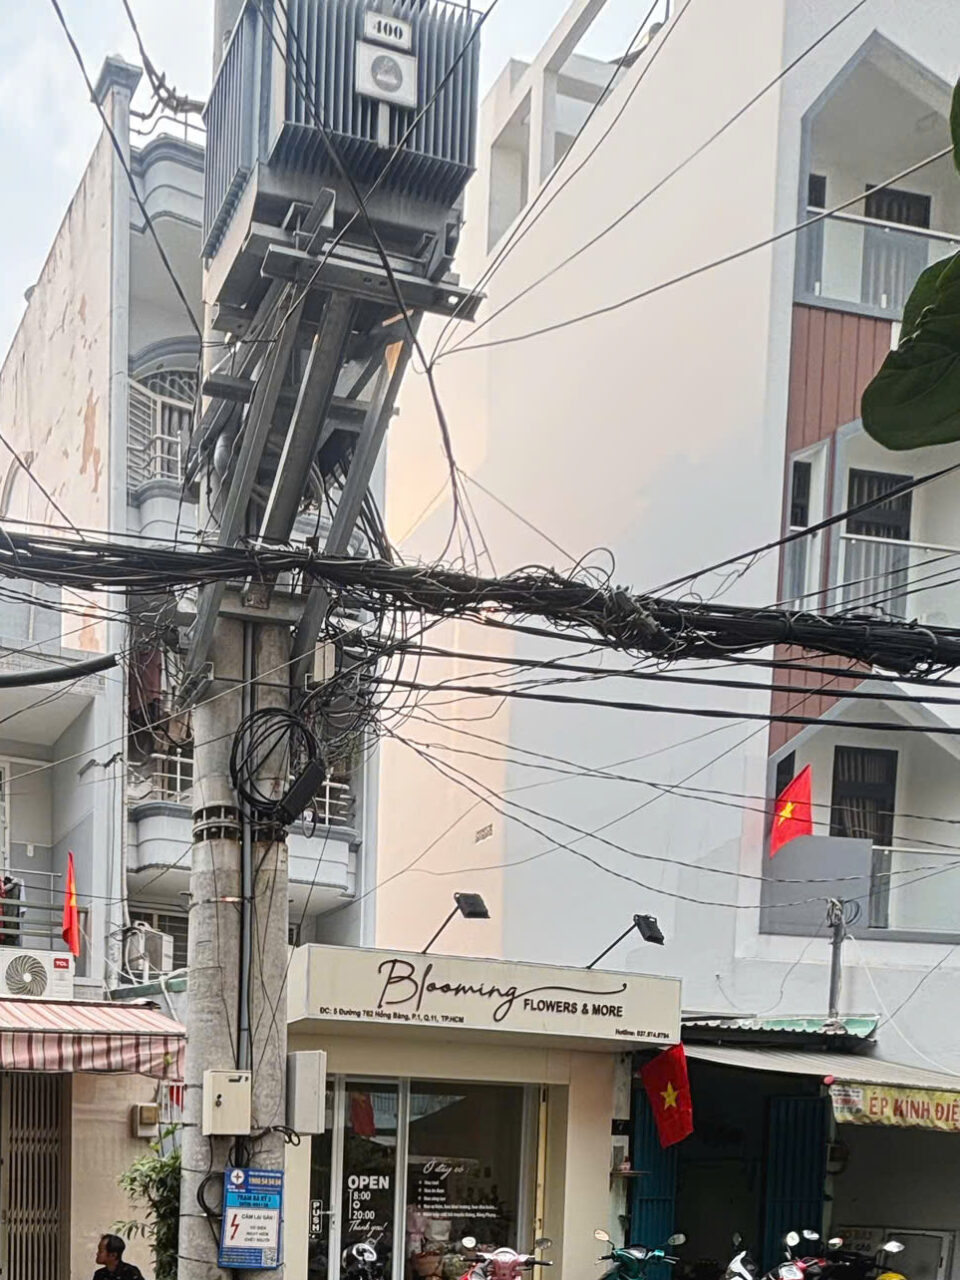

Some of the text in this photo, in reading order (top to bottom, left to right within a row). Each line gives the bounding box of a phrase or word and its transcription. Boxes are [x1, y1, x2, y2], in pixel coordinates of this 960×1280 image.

[378, 959, 519, 1022] Blooming
[523, 999, 623, 1018] FLOWERS & MORE
[869, 1091, 888, 1116] ÉP
[893, 1095, 931, 1120] KÍNH
[347, 1175, 390, 1189] OPEN
[353, 1191, 371, 1200] 8:00
[312, 1201, 320, 1231] PUSH
[353, 1210, 375, 1220] 20:00
[348, 1220, 370, 1232] Thank
